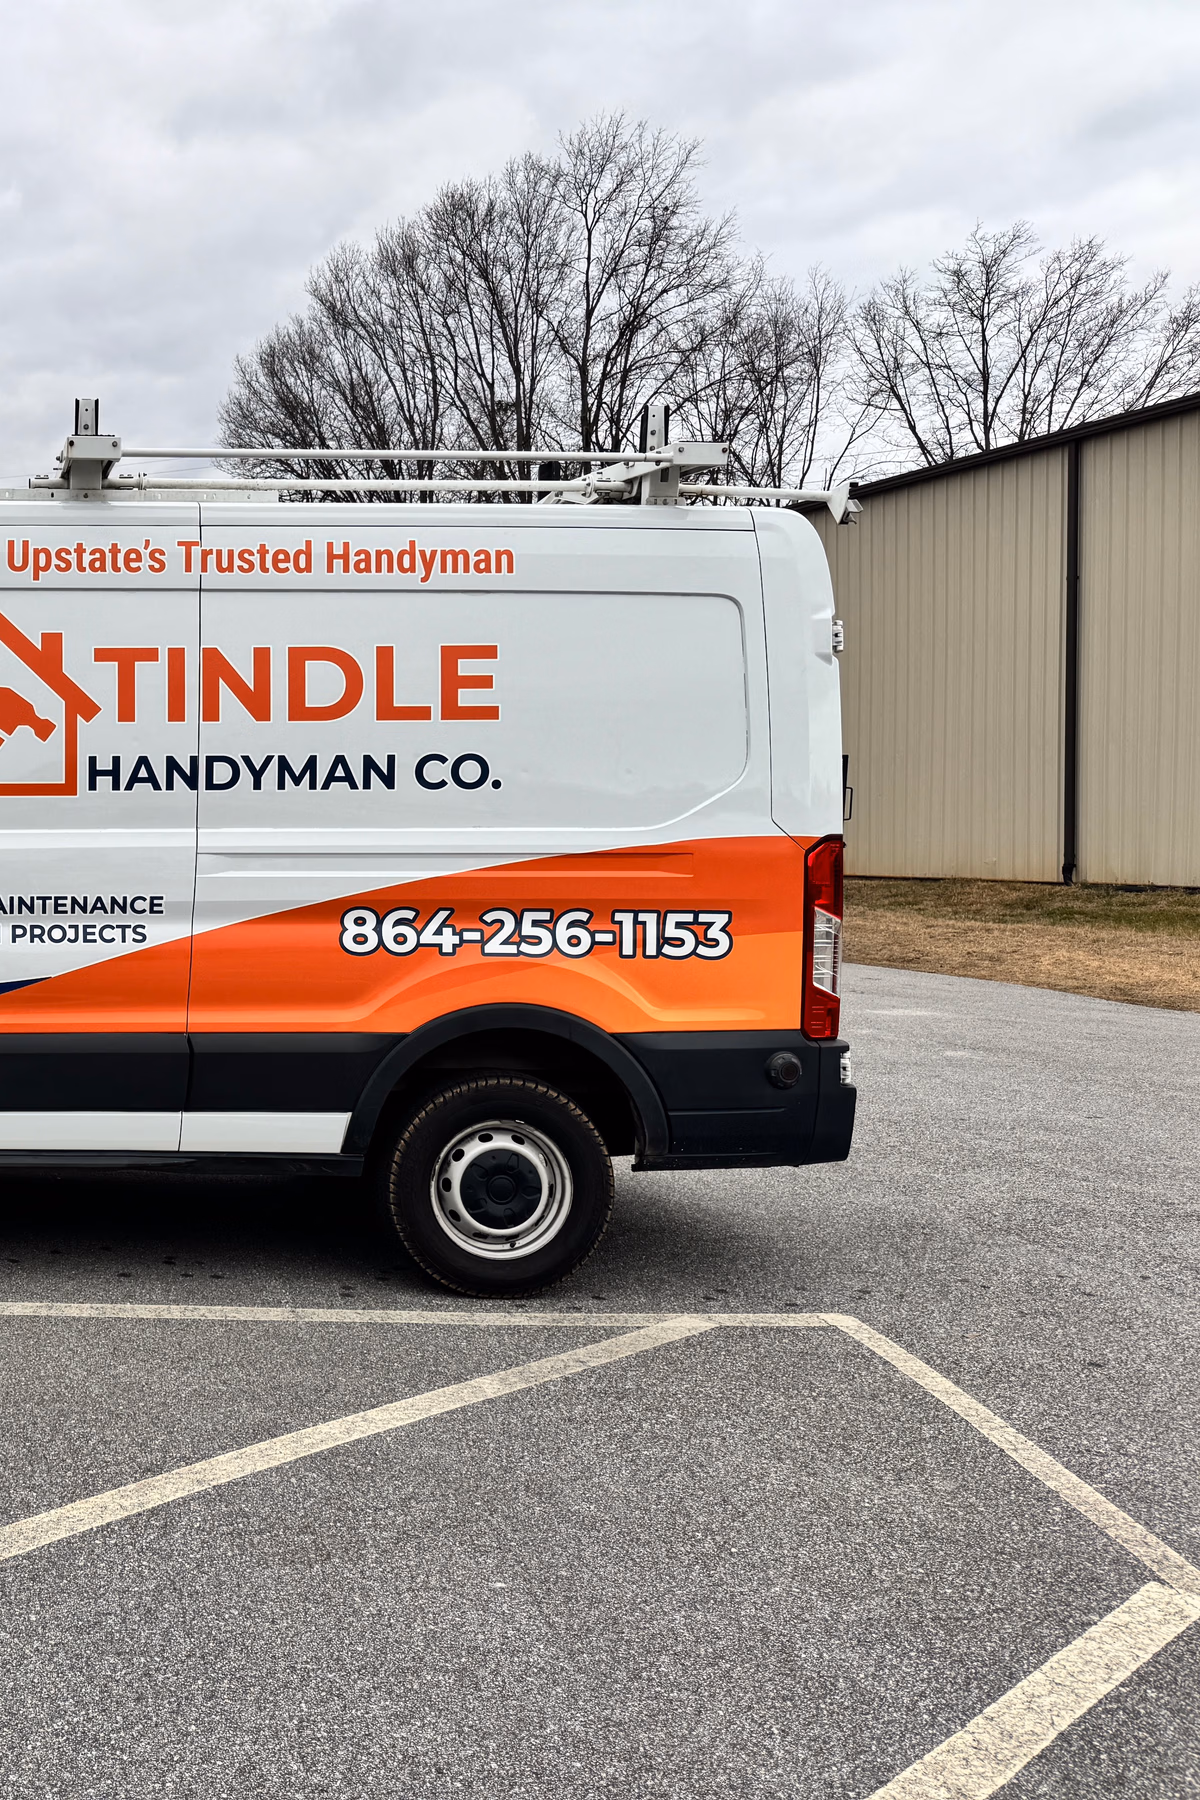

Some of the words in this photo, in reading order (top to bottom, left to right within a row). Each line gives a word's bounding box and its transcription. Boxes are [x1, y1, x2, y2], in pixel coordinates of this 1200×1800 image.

[8, 539, 166, 581] Upstate’s
[178, 540, 312, 574] Trusted
[327, 541, 514, 583] Handyman
[94, 645, 500, 723] TINDLE
[88, 755, 396, 792] HANDYMAN
[414, 753, 502, 790] CO.
[11, 924, 147, 944] PROJECTS
[339, 906, 734, 961] 864-256-1153
